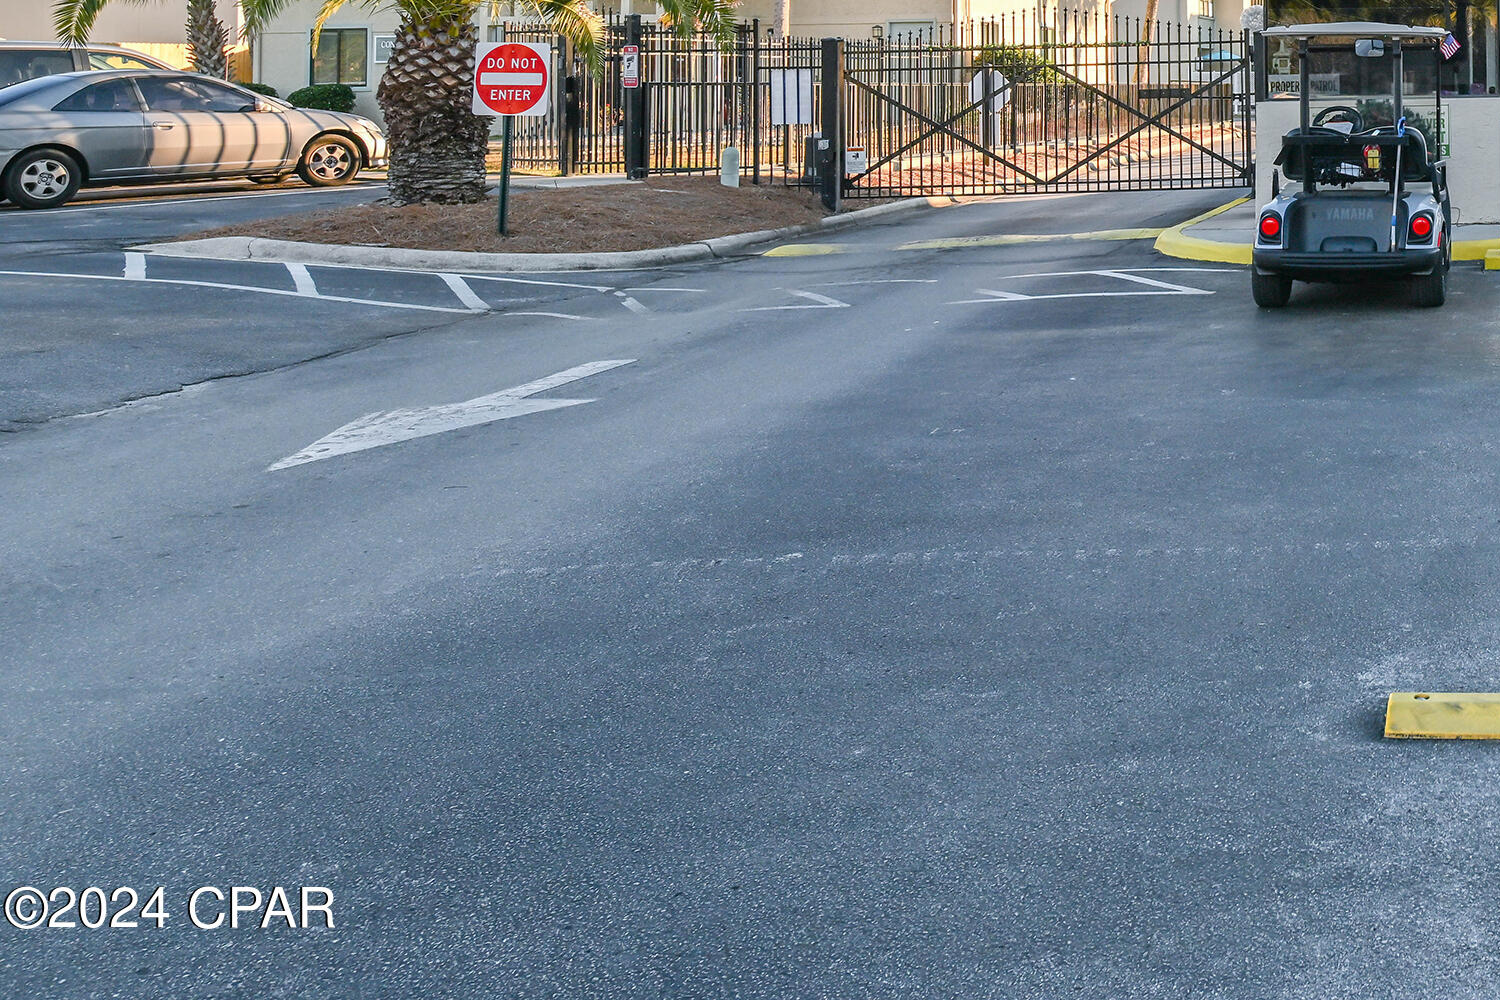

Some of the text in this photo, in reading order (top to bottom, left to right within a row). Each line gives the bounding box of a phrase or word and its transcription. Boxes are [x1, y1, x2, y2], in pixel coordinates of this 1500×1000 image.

[487, 58, 538, 69] DO NOT
[1270, 81, 1300, 92] PROPER
[490, 89, 531, 101] ENTER
[1327, 207, 1375, 220] YAMAHA
